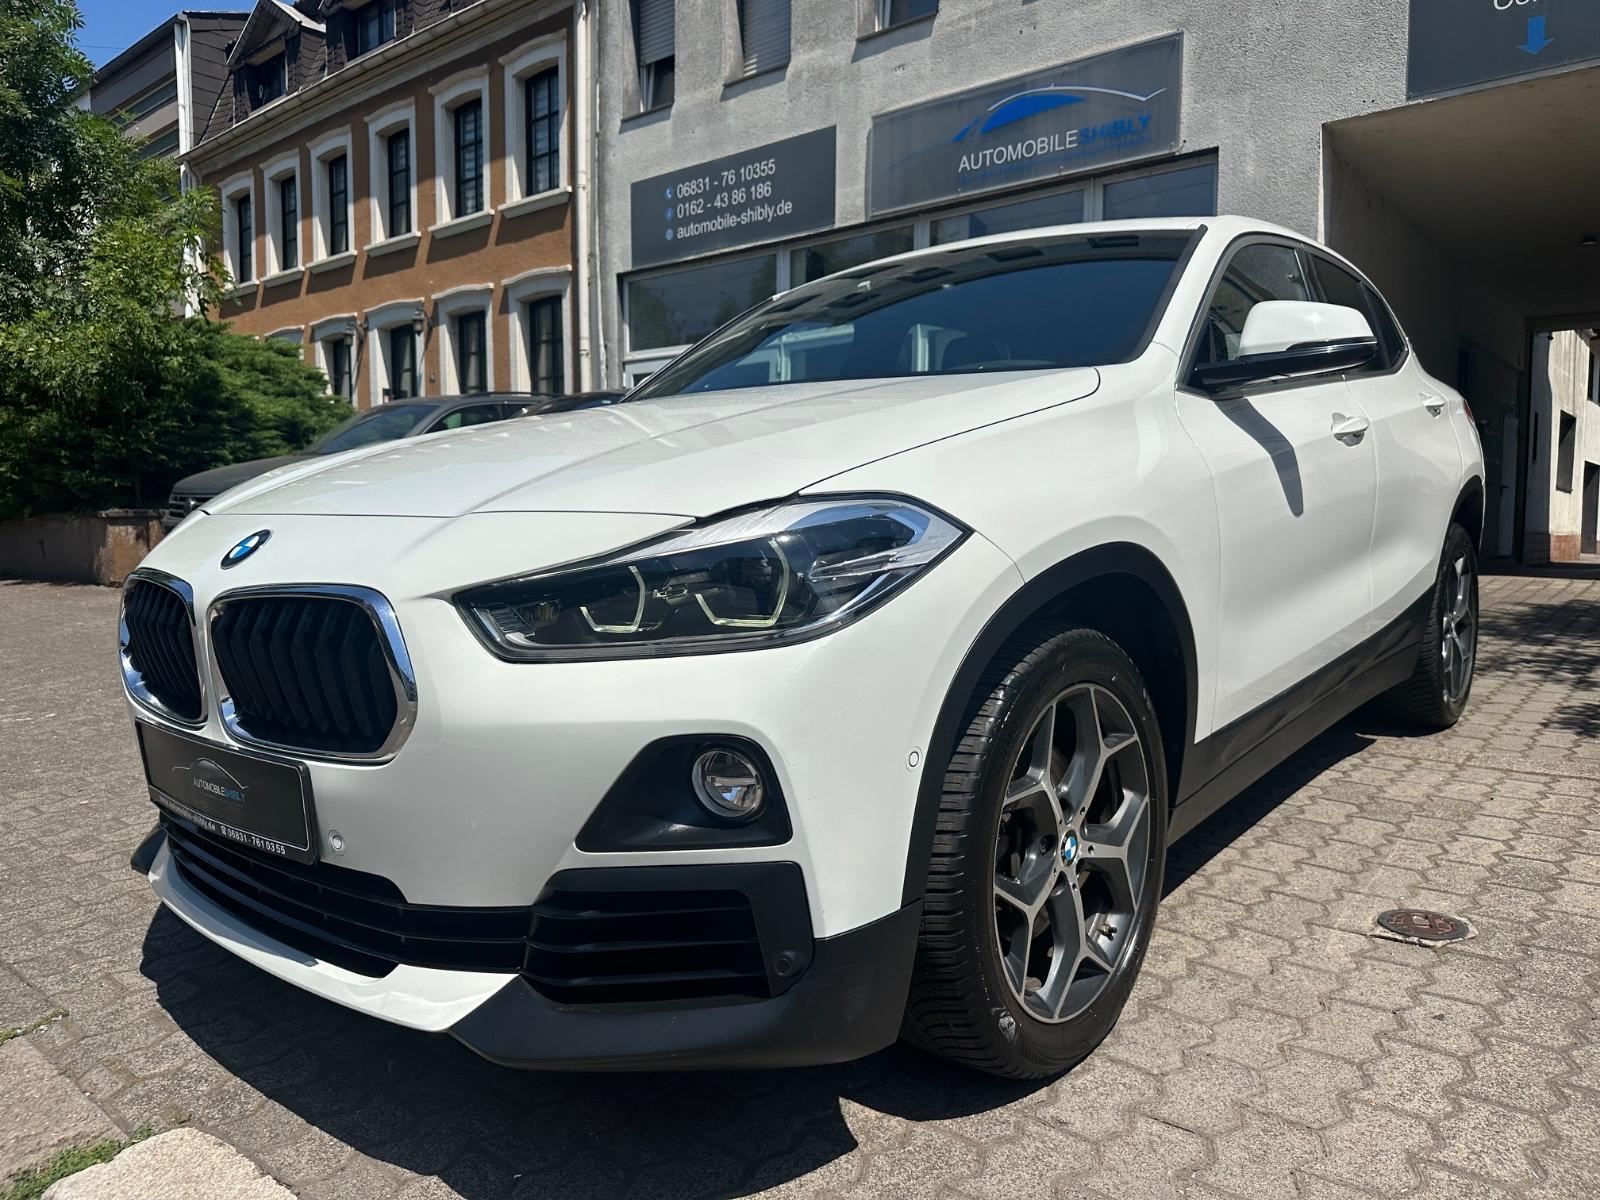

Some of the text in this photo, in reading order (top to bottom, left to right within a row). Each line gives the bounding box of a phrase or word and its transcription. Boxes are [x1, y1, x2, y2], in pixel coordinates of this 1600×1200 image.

[676, 177, 710, 198] 06831
[721, 170, 736, 187] 76
[739, 158, 776, 182] 10355
[676, 198, 704, 218] 0162
[714, 192, 729, 209] 43
[731, 188, 746, 204] 86
[749, 181, 772, 201] 186
[676, 199, 793, 239] automobile-shibly.de
